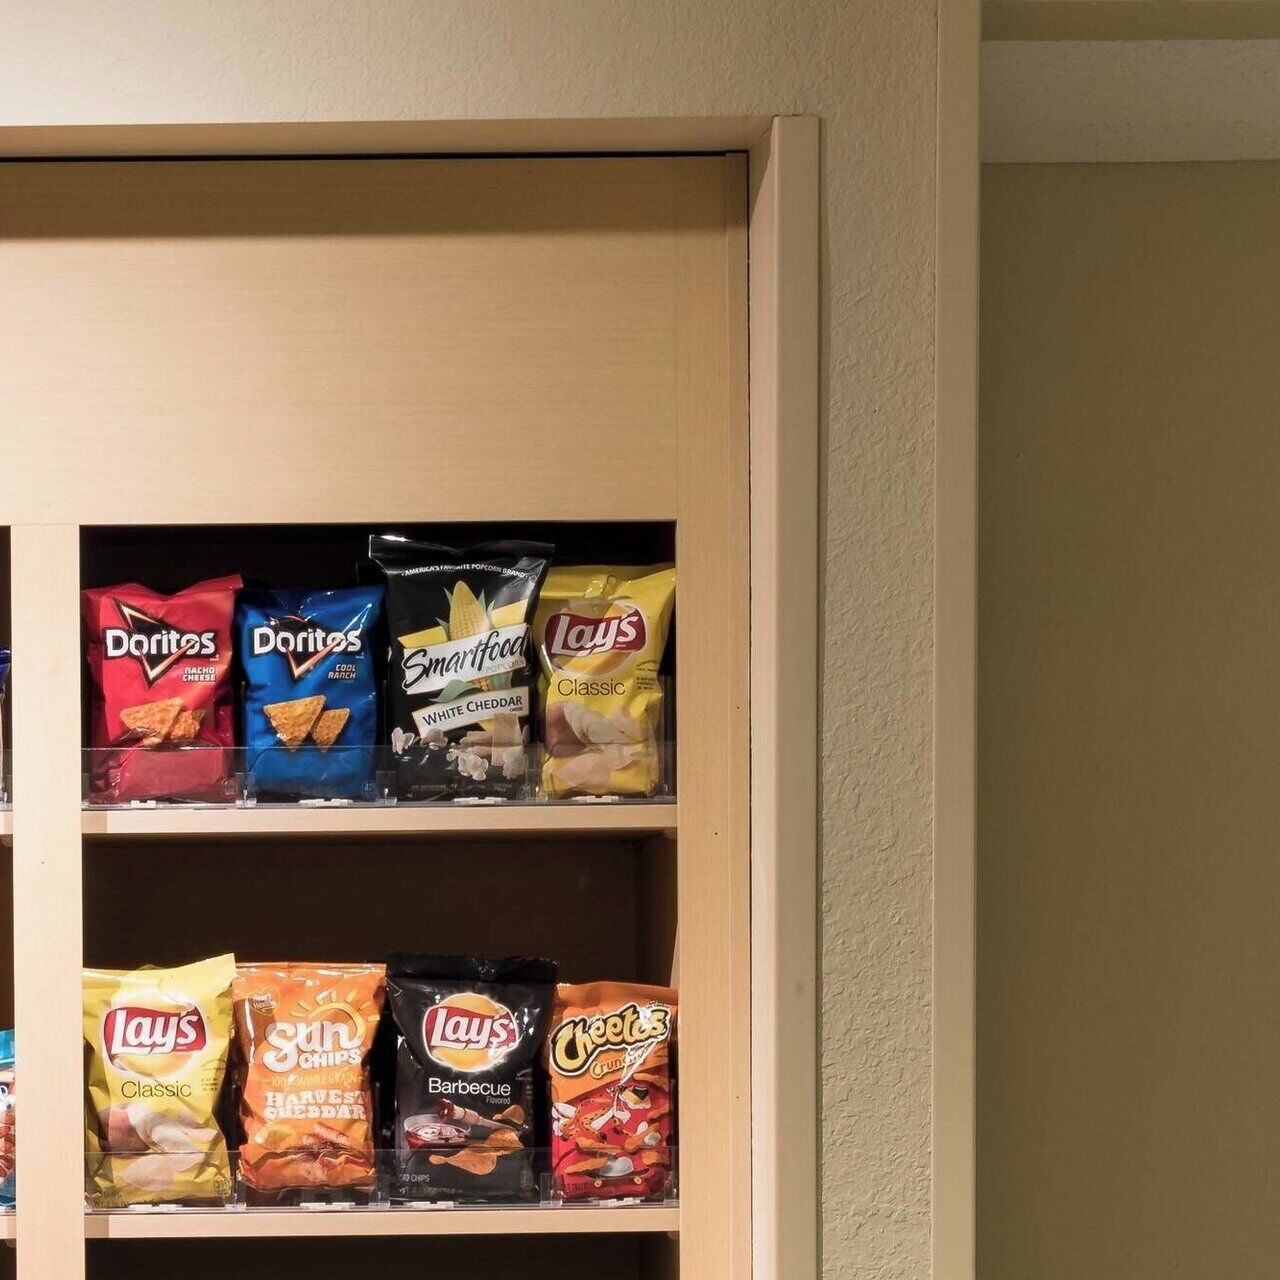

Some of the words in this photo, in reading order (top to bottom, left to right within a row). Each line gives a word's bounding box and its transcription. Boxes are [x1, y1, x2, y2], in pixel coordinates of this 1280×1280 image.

[106, 629, 216, 657] Doritos
[254, 627, 362, 656] Doritos
[551, 612, 639, 657] Lay's
[335, 664, 356, 672] COOL
[402, 626, 529, 690] Smartfood
[182, 674, 217, 683] CHEESE
[184, 666, 216, 675] NACHO
[328, 672, 356, 681] RANCH
[557, 678, 627, 698] Classic
[422, 706, 465, 727] WHITE
[466, 694, 524, 714] CHEDDAR
[111, 1008, 199, 1056] Lay's
[430, 1007, 510, 1051] Lay's
[552, 1004, 671, 1075] Cheetos
[299, 1048, 361, 1070] CHIPS
[120, 1080, 192, 1099] Classic
[265, 1089, 365, 1106] HARVEST
[428, 1079, 511, 1096] Barbecue
[263, 1104, 367, 1120] CHEDDAR
